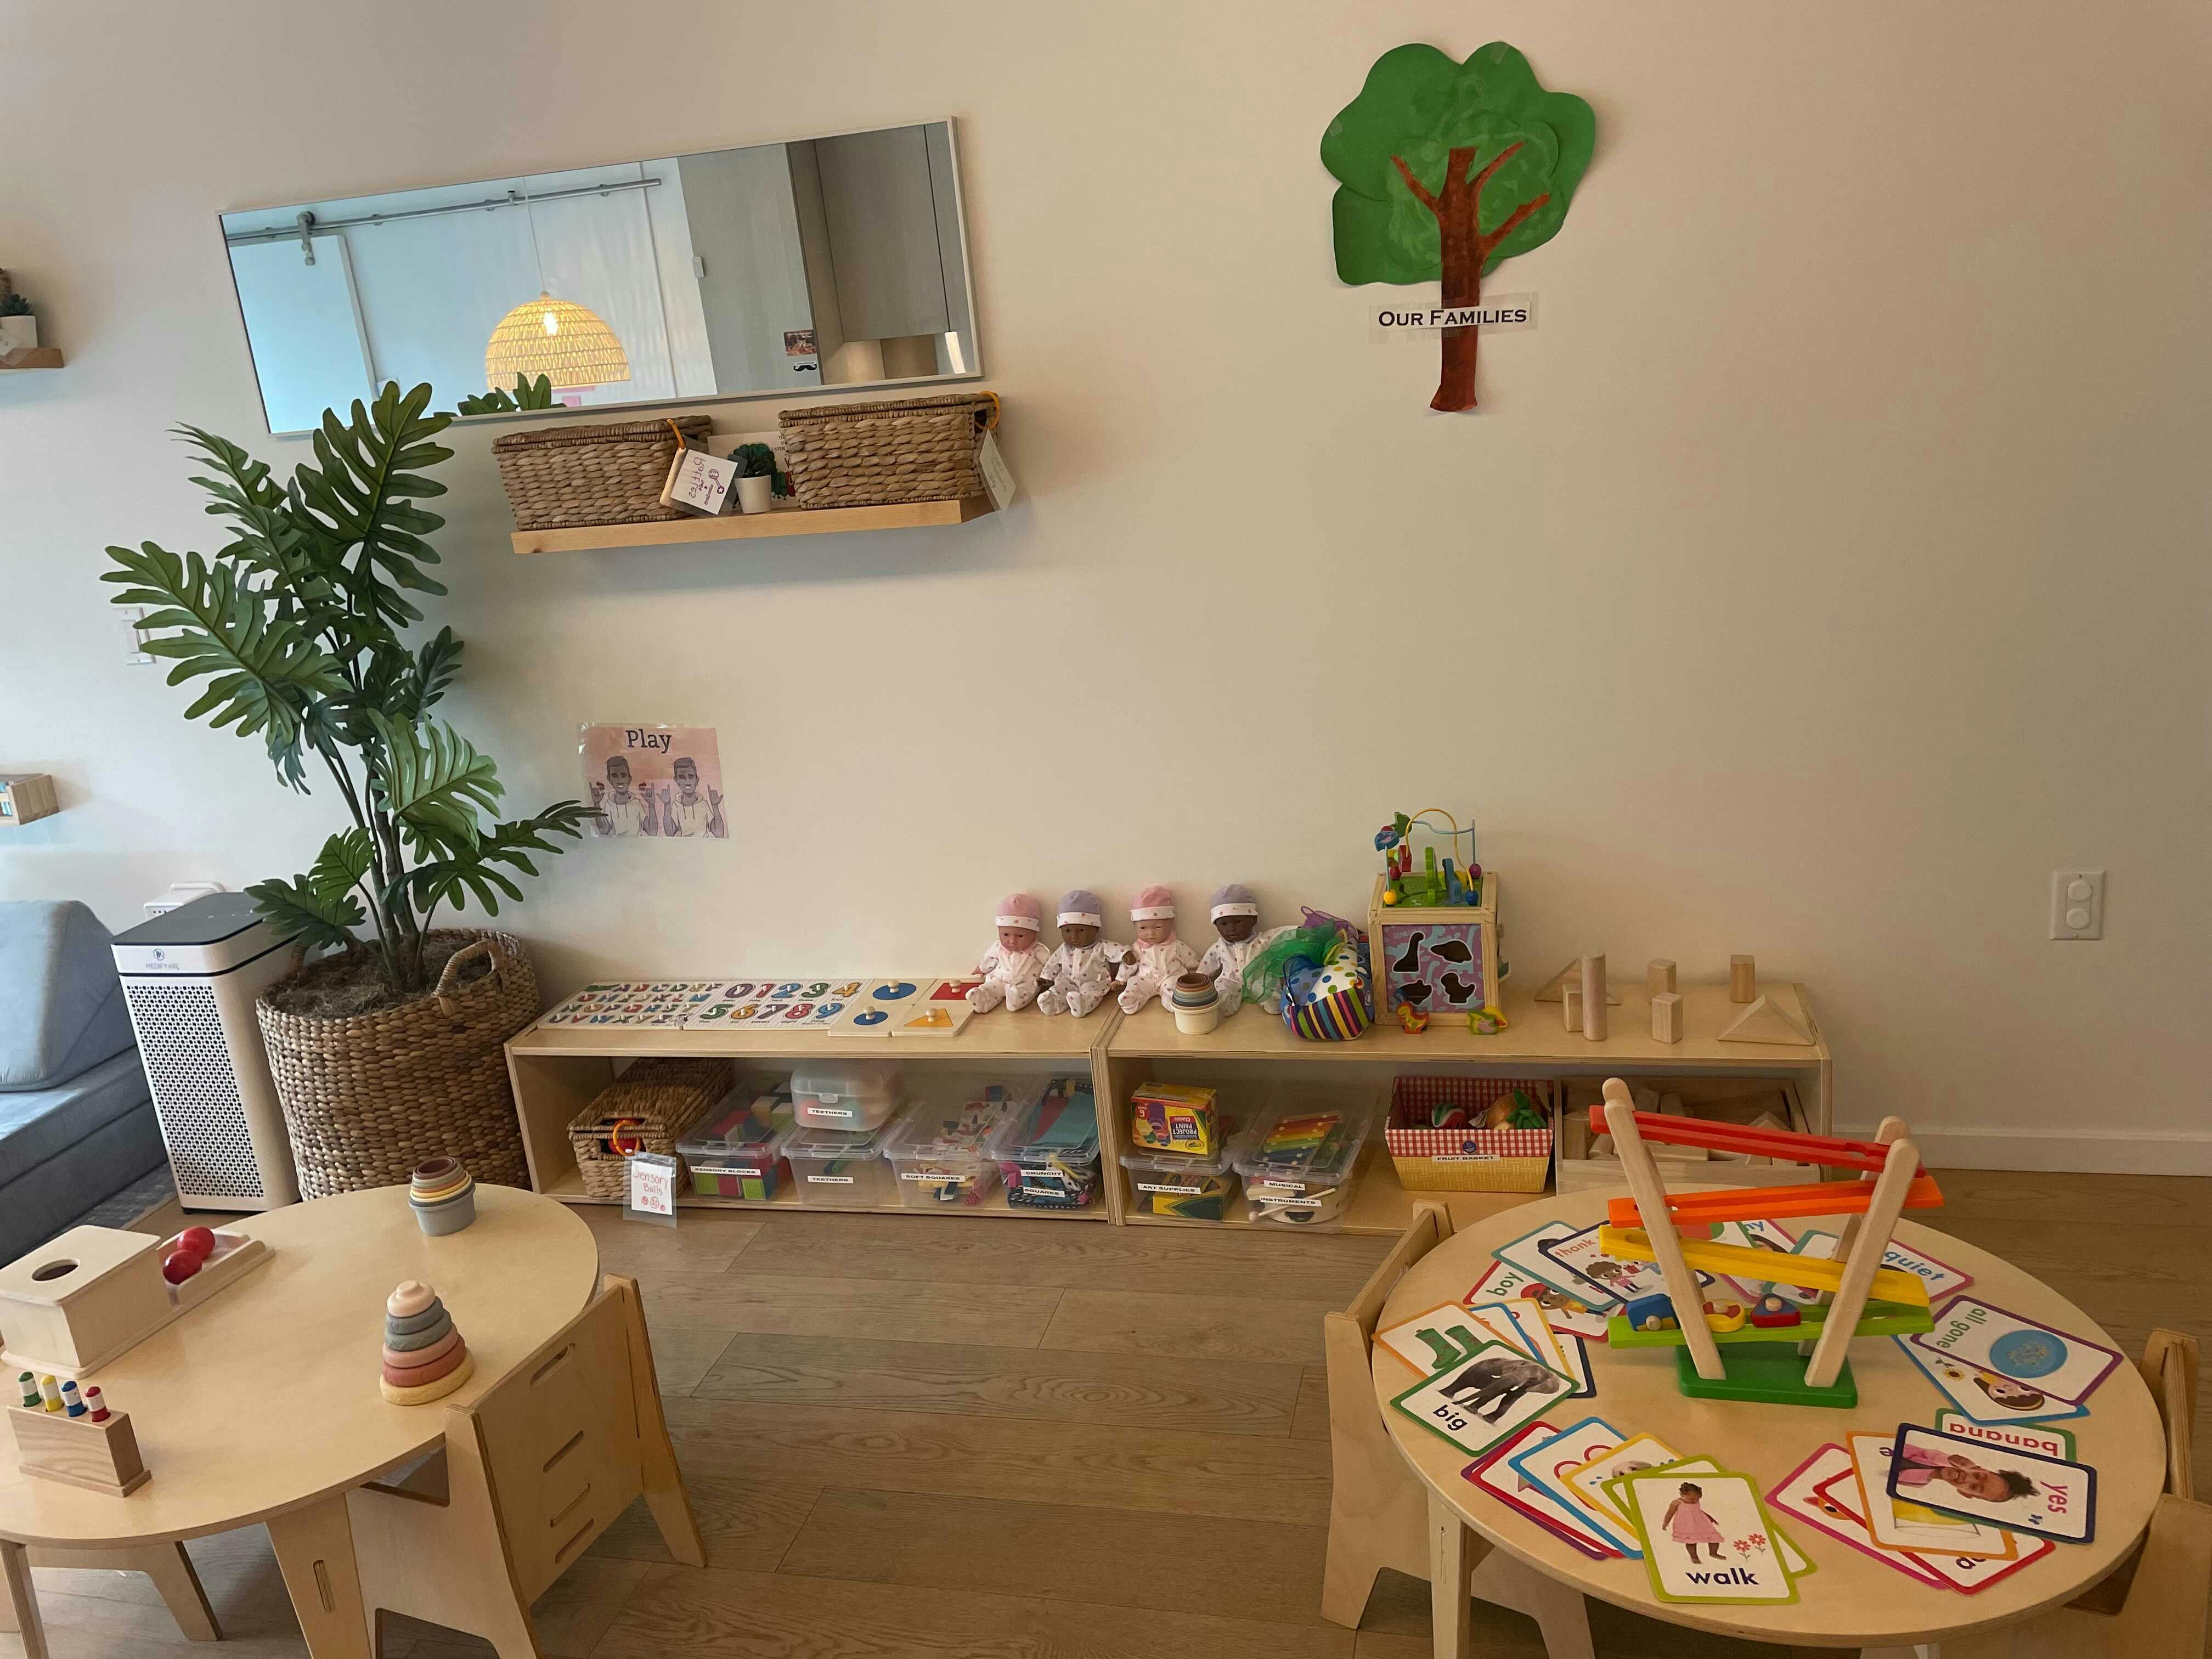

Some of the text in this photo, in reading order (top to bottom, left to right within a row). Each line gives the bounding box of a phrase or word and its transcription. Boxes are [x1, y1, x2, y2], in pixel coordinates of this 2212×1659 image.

[1378, 308, 1527, 326] OUR FAMILIES
[625, 728, 672, 754] Play
[725, 982, 862, 998] 0 1 2 3 4
[699, 1003, 845, 1019] 5 6 7 8 9
[633, 1165, 669, 1191] Sensory
[643, 1182, 663, 1195] Balls
[1024, 1188, 1059, 1196] SQUARES
[1261, 1197, 1316, 1205] INSTRUMENTS
[1554, 1238, 1596, 1257] thank
[1884, 1250, 1946, 1282] quiet
[1486, 1271, 1525, 1296] boy
[1937, 1307, 1988, 1349] all gone
[1433, 1403, 1468, 1431] big
[1949, 1422, 2058, 1457] banana
[2040, 1480, 2068, 1514] yes
[1685, 1567, 1759, 1585] walk
